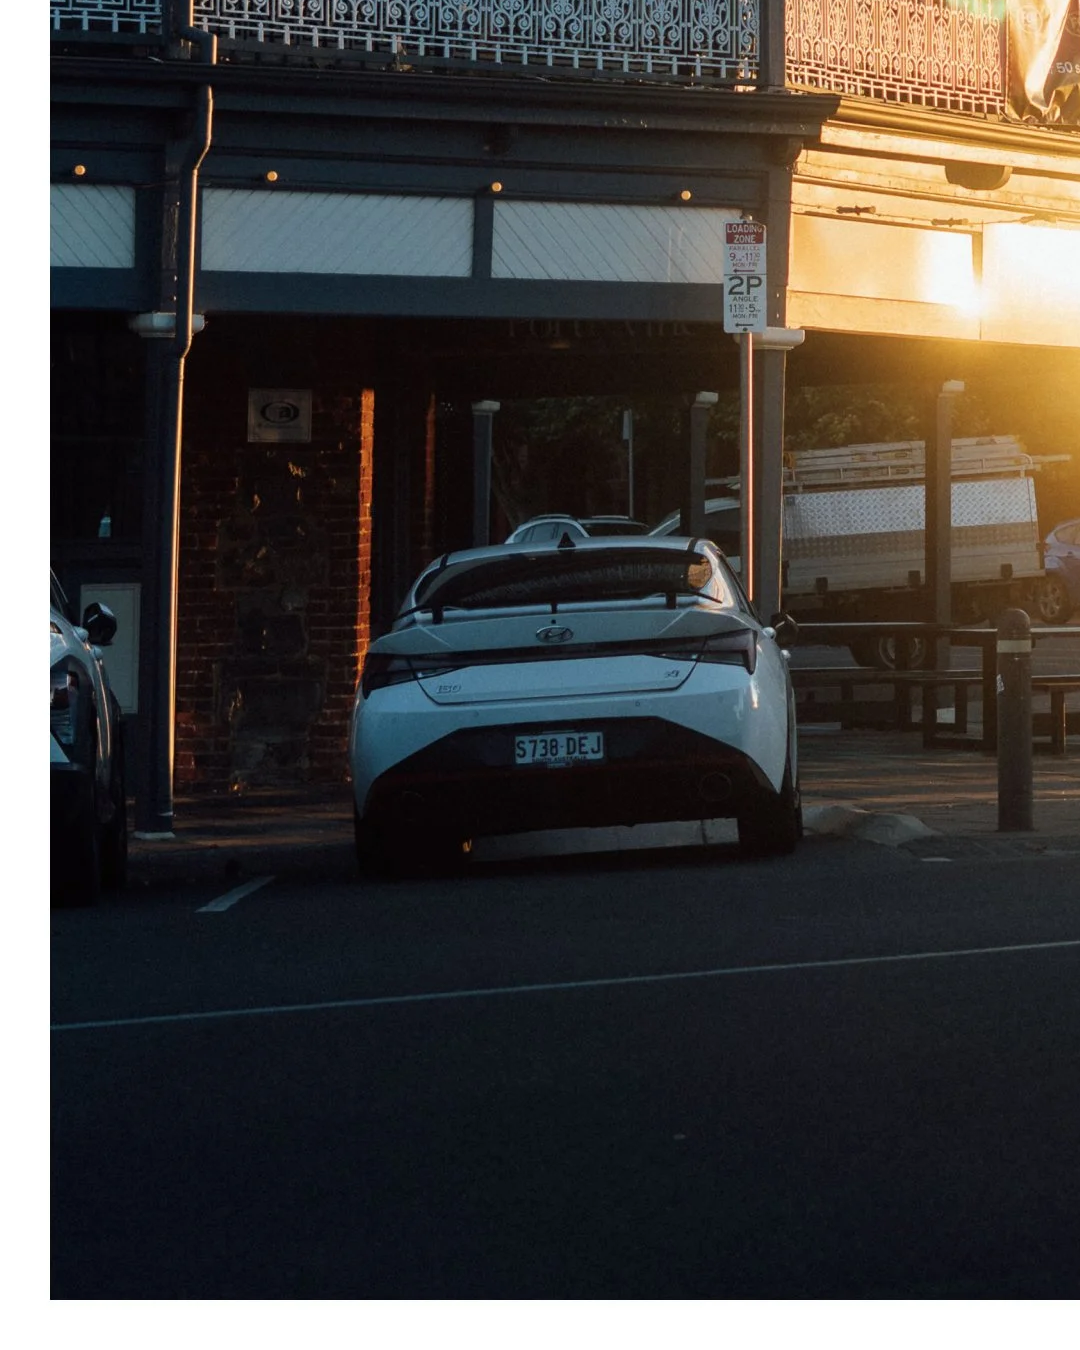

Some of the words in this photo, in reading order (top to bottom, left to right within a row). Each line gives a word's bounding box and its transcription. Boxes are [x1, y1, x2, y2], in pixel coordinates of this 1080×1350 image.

[727, 224, 763, 233] LOADING
[734, 235, 756, 244] ZONE
[728, 275, 763, 295] 2P
